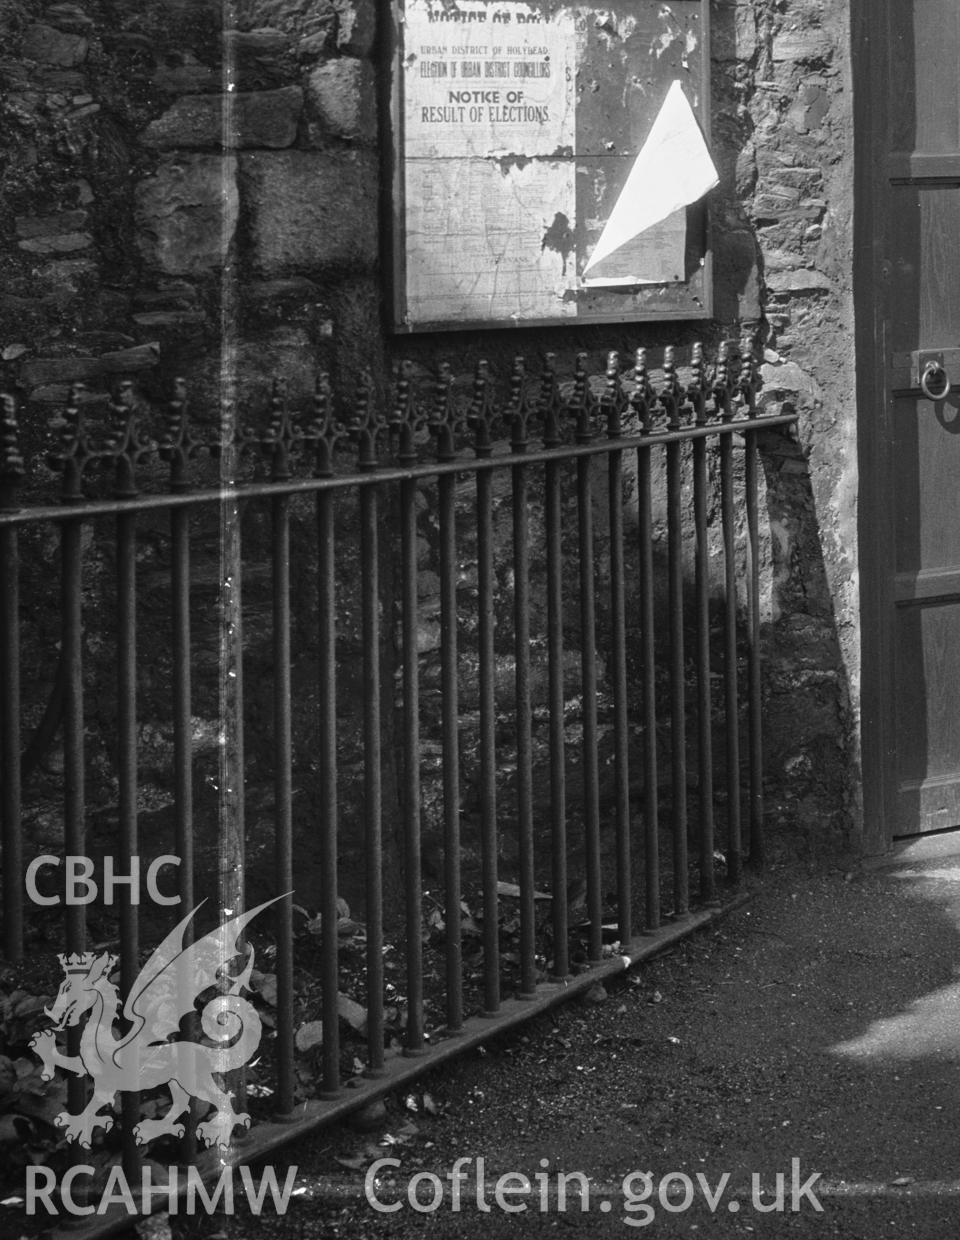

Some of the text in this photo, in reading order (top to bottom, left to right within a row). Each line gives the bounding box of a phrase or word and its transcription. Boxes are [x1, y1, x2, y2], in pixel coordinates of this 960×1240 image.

[420, 45, 447, 55] URBAN
[452, 45, 488, 55] DISTRICT
[492, 45, 503, 55] OF
[420, 61, 448, 78] ELECTION
[461, 61, 482, 78] URBAN
[484, 62, 510, 78] DISTRICT
[514, 62, 551, 78] COUNCILLORS
[449, 91, 524, 103] NOTICE OF
[421, 106, 466, 123] RESULT
[469, 106, 484, 123] OF
